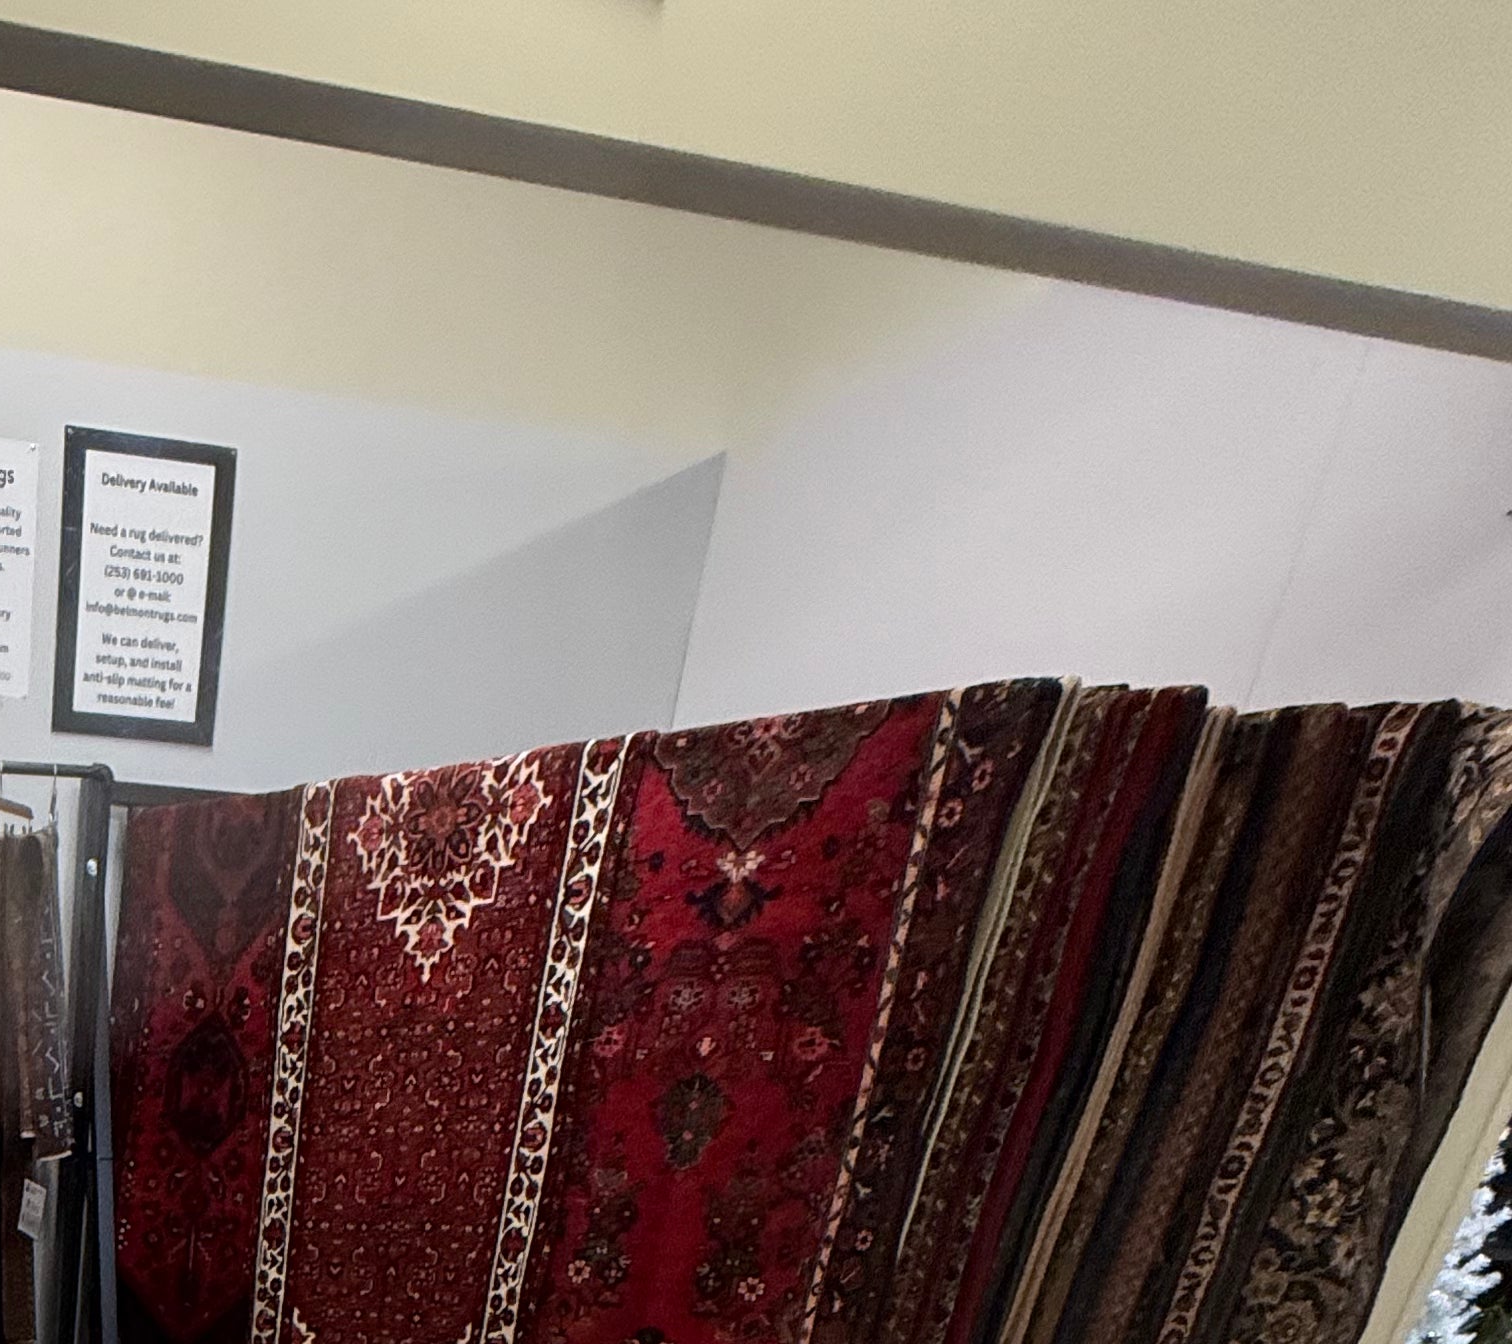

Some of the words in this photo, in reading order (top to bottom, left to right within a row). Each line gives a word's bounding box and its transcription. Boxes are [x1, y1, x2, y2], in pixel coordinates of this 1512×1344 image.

[101, 472, 147, 493] Delivery
[149, 479, 199, 497] Available
[90, 522, 118, 538] Need
[120, 529, 126, 538] a
[129, 530, 146, 543] rug
[149, 530, 204, 547] delivered?
[110, 545, 151, 562] Contact
[154, 552, 166, 563] us
[167, 553, 181, 565] at:
[104, 565, 131, 580] (253)
[114, 587, 125, 598] or
[138, 588, 171, 602] e-mail:
[85, 600, 198, 623] info@belmontrugs.com
[102, 633, 118, 645] We
[120, 637, 139, 648] can
[140, 637, 179, 653] deliver,
[95, 653, 128, 668] setup,
[129, 657, 149, 668] and
[151, 658, 183, 672] install
[83, 671, 125, 687] anti-slip
[127, 677, 167, 692] matting
[169, 678, 183, 691] for
[185, 684, 192, 693] a
[97, 693, 153, 708] reasonable
